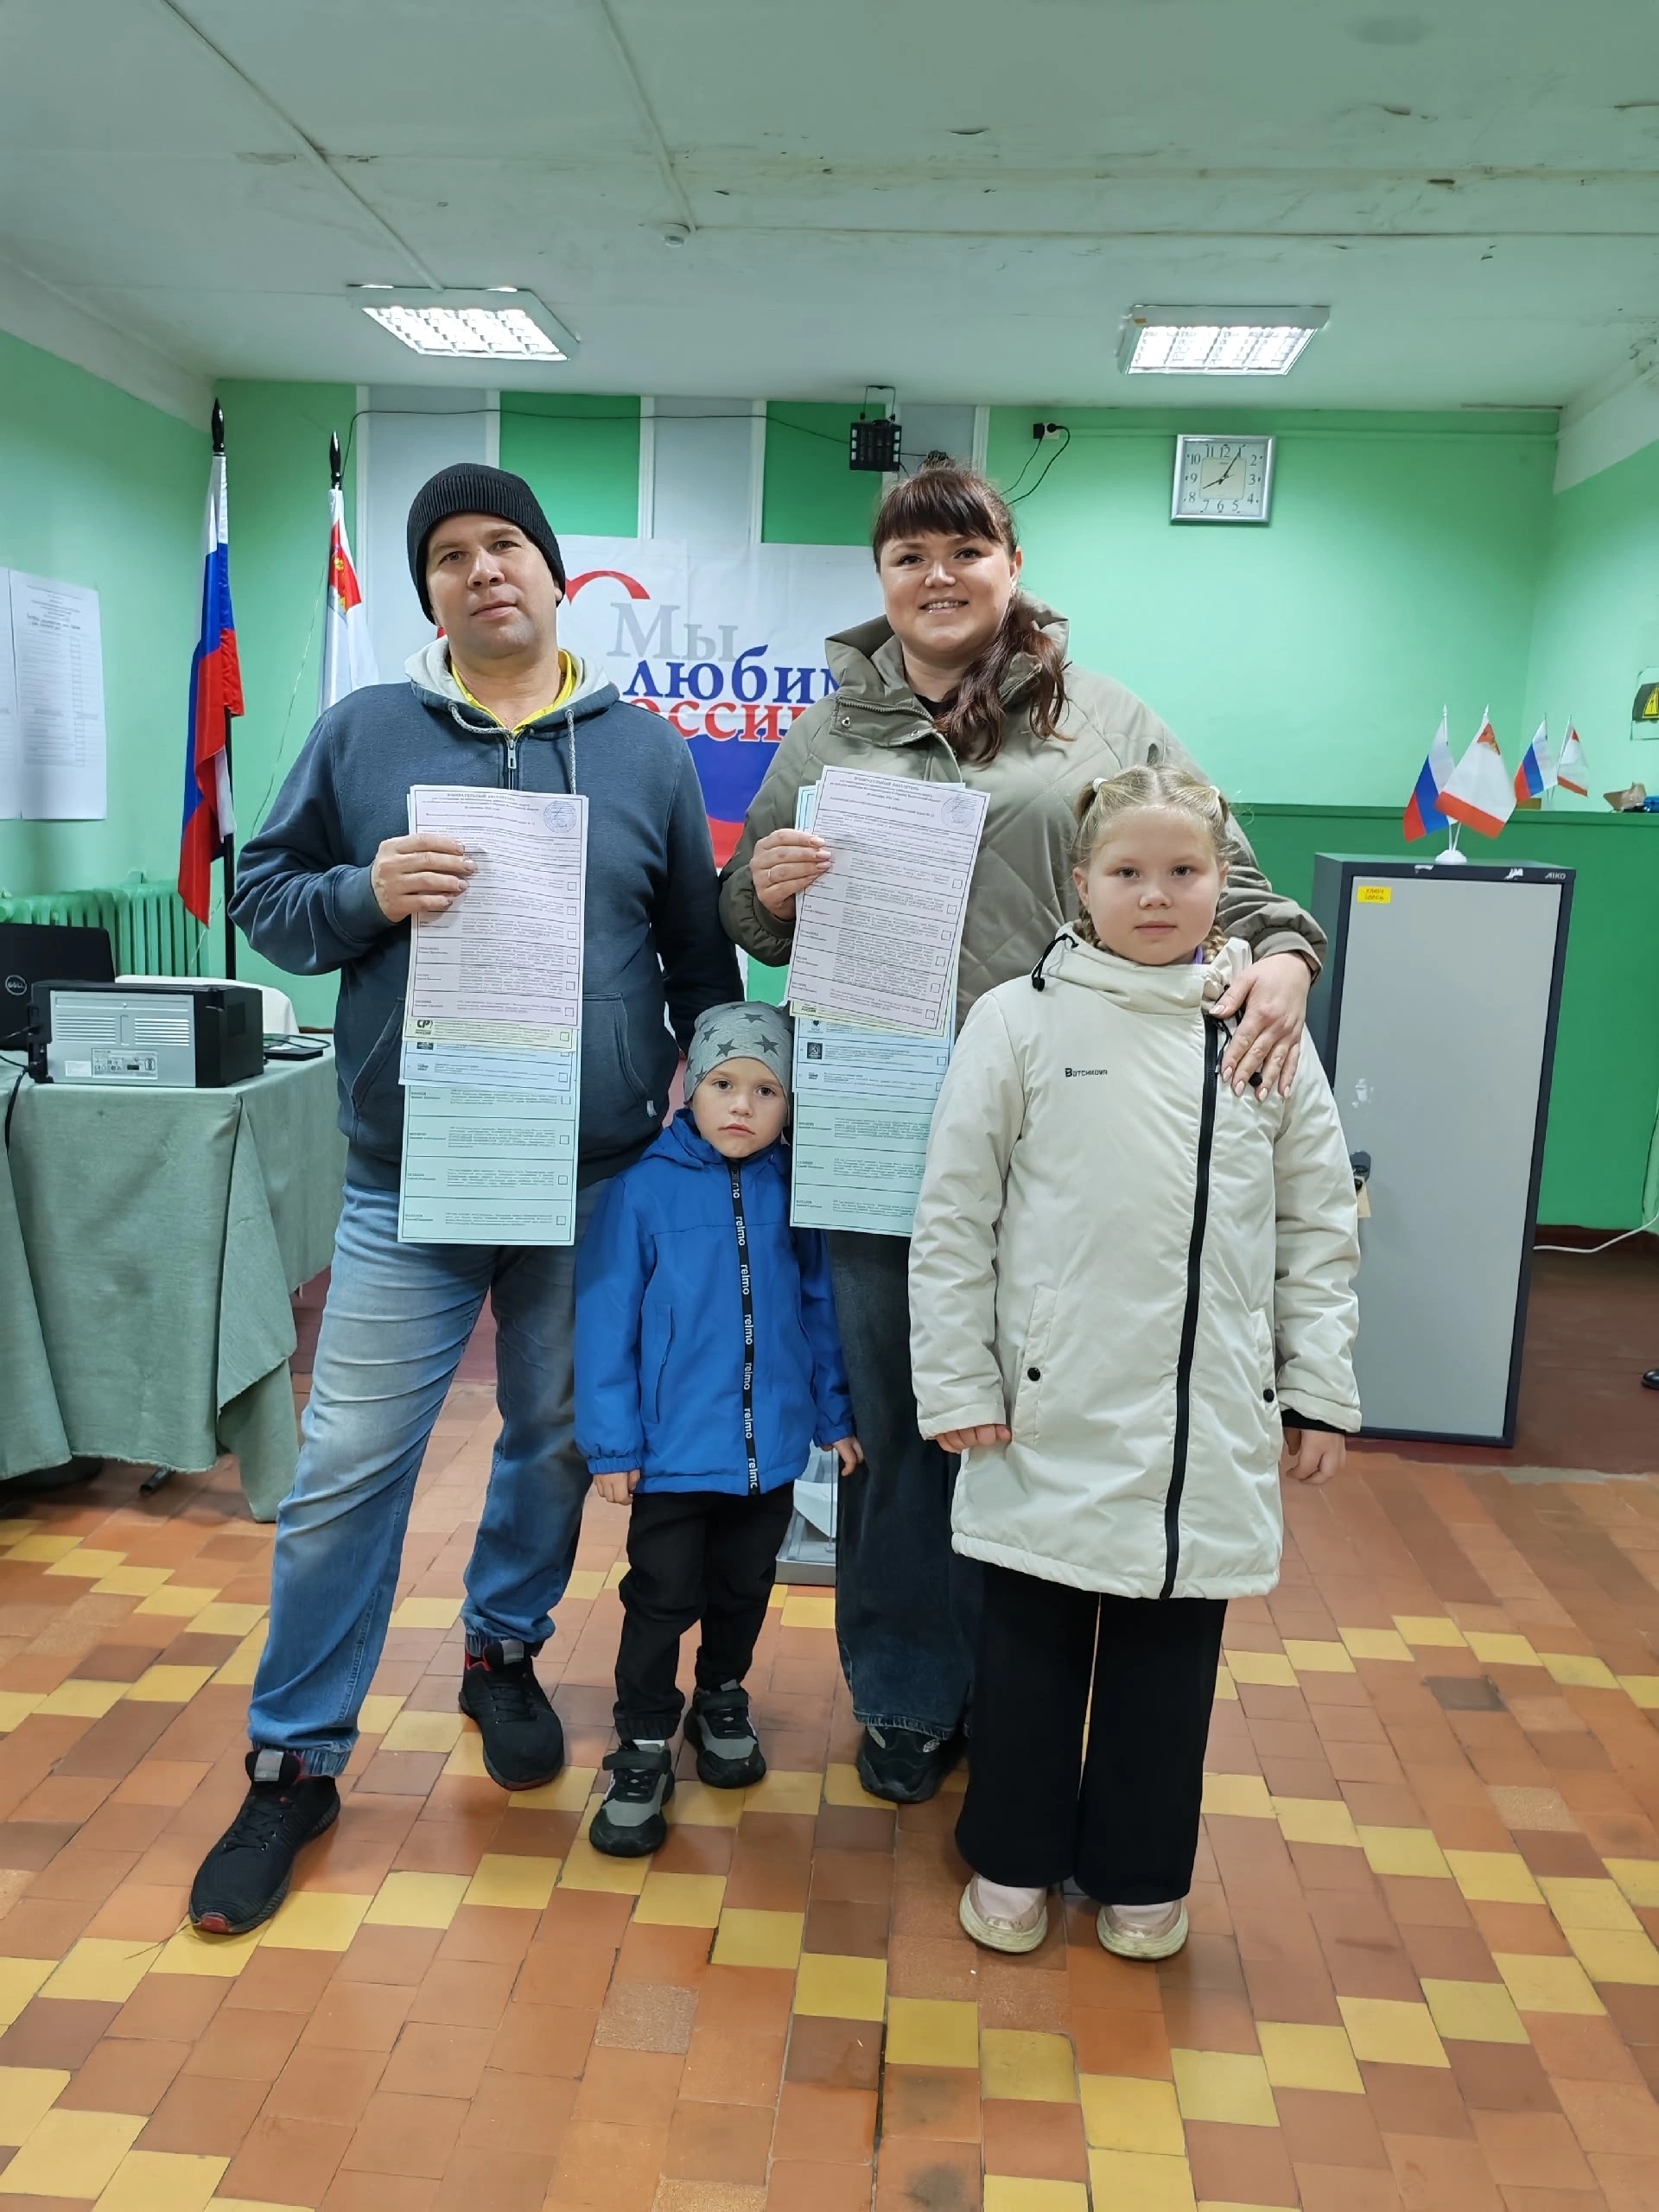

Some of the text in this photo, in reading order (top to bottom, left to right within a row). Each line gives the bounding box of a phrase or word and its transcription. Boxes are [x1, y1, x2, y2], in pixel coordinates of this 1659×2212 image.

[1219, 445, 1230, 458] 12
[1190, 454, 1201, 465] 10
[1249, 454, 1257, 466] 2
[1190, 474, 1198, 483] 9
[1248, 474, 1255, 485] 3
[1188, 492, 1196, 503] 8
[1247, 493, 1254, 504] 4
[1202, 499, 1209, 511] 7
[1217, 500, 1224, 512] 6
[1232, 500, 1239, 512] 5
[607, 602, 738, 663] Мы
[735, 1216, 746, 1246] relmo
[740, 1264, 751, 1295] relmo
[744, 1314, 754, 1345] relmo
[743, 1363, 753, 1390] relmo
[744, 1408, 753, 1439] relmo
